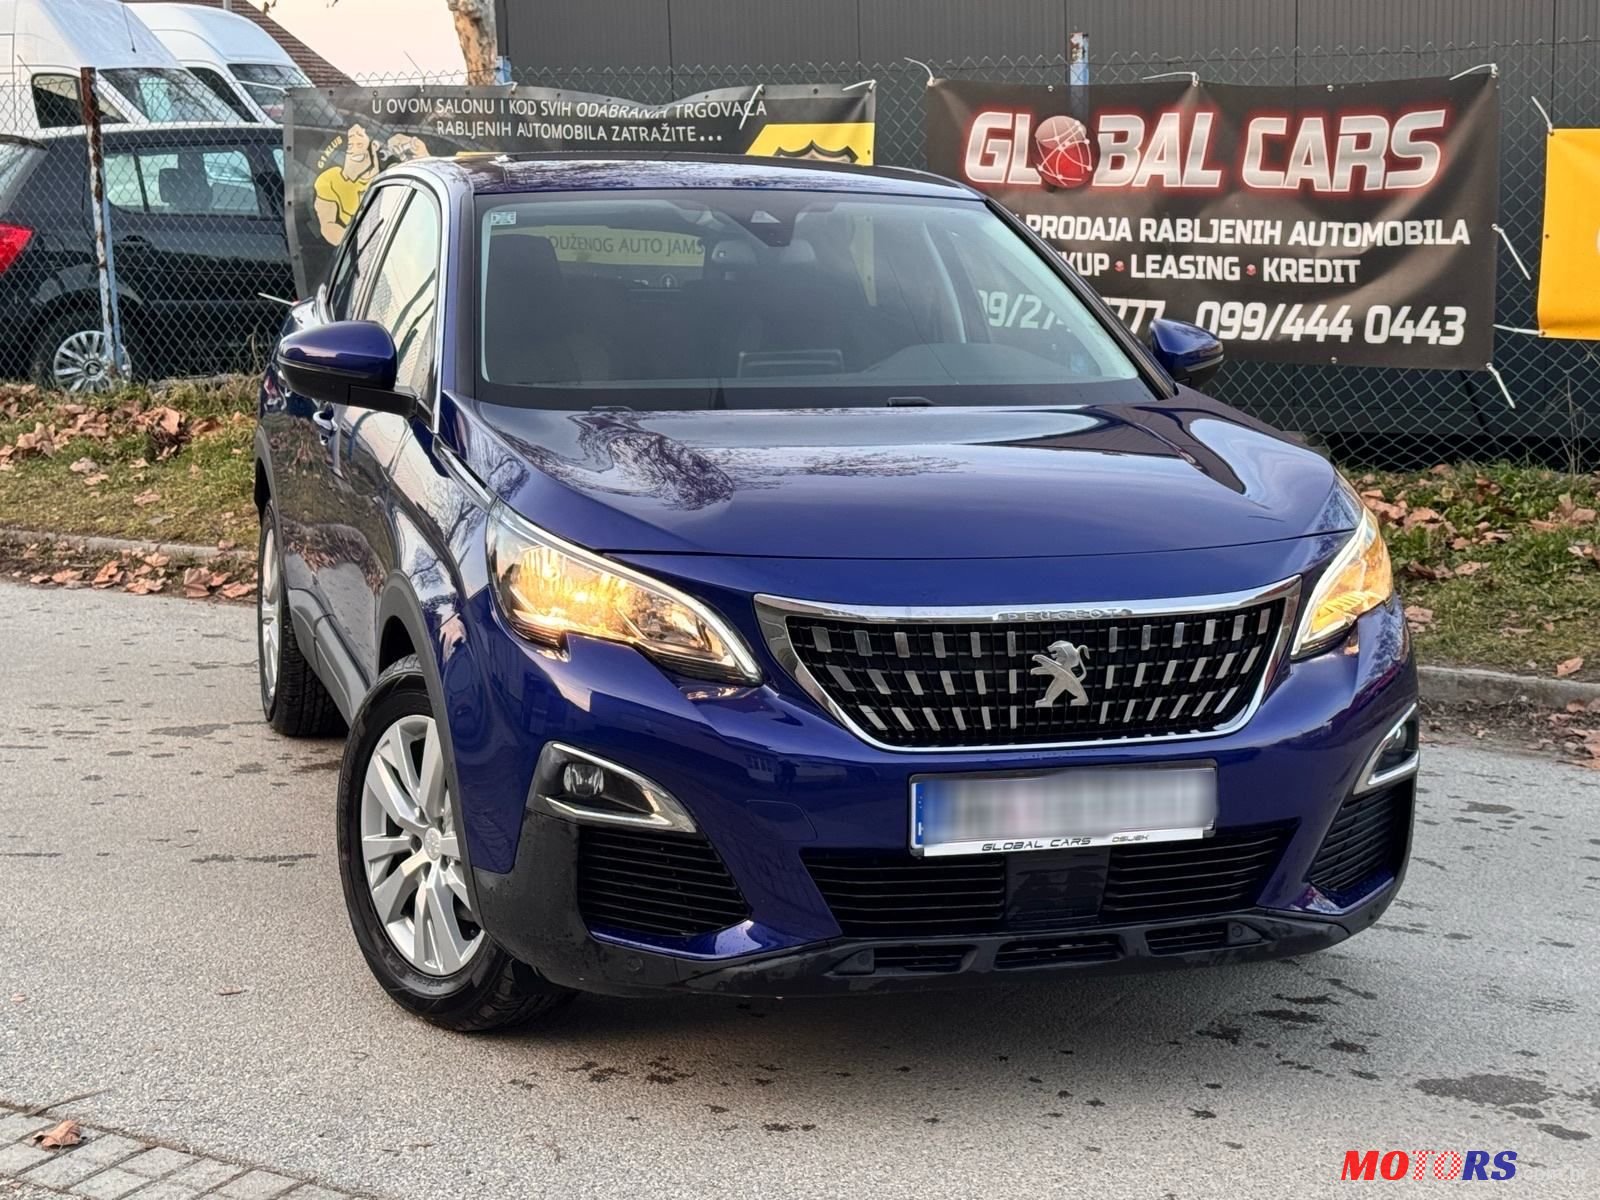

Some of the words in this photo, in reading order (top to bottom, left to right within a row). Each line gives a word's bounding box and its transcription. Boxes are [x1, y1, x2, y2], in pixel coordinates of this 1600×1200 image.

[372, 99, 382, 114] U
[386, 99, 433, 114] OVOM
[435, 99, 495, 115] SALONU
[500, 99, 505, 115] I
[508, 99, 537, 116] KOD
[541, 100, 572, 117] SVIH
[436, 120, 512, 140] RABLJENIH
[516, 121, 608, 142] AUTOMOBILA
[323, 135, 343, 158] KLUB
[964, 110, 1223, 189] GLOBAL
[1242, 108, 1447, 192] CARS
[1025, 214, 1133, 242] PRODAJA
[1139, 217, 1283, 245] RABLJENIH
[1287, 218, 1471, 247] AUTOMOBILA
[618, 238, 663, 254] AUTO
[1130, 254, 1241, 281] LEASING
[1262, 257, 1361, 284] KREDIT
[1195, 300, 1354, 344] 099/444
[1364, 304, 1467, 346] 0443
[1006, 608, 1118, 621] PEUGEOT
[982, 841, 1044, 852] GLOBAL
[1050, 837, 1092, 848] CARS
